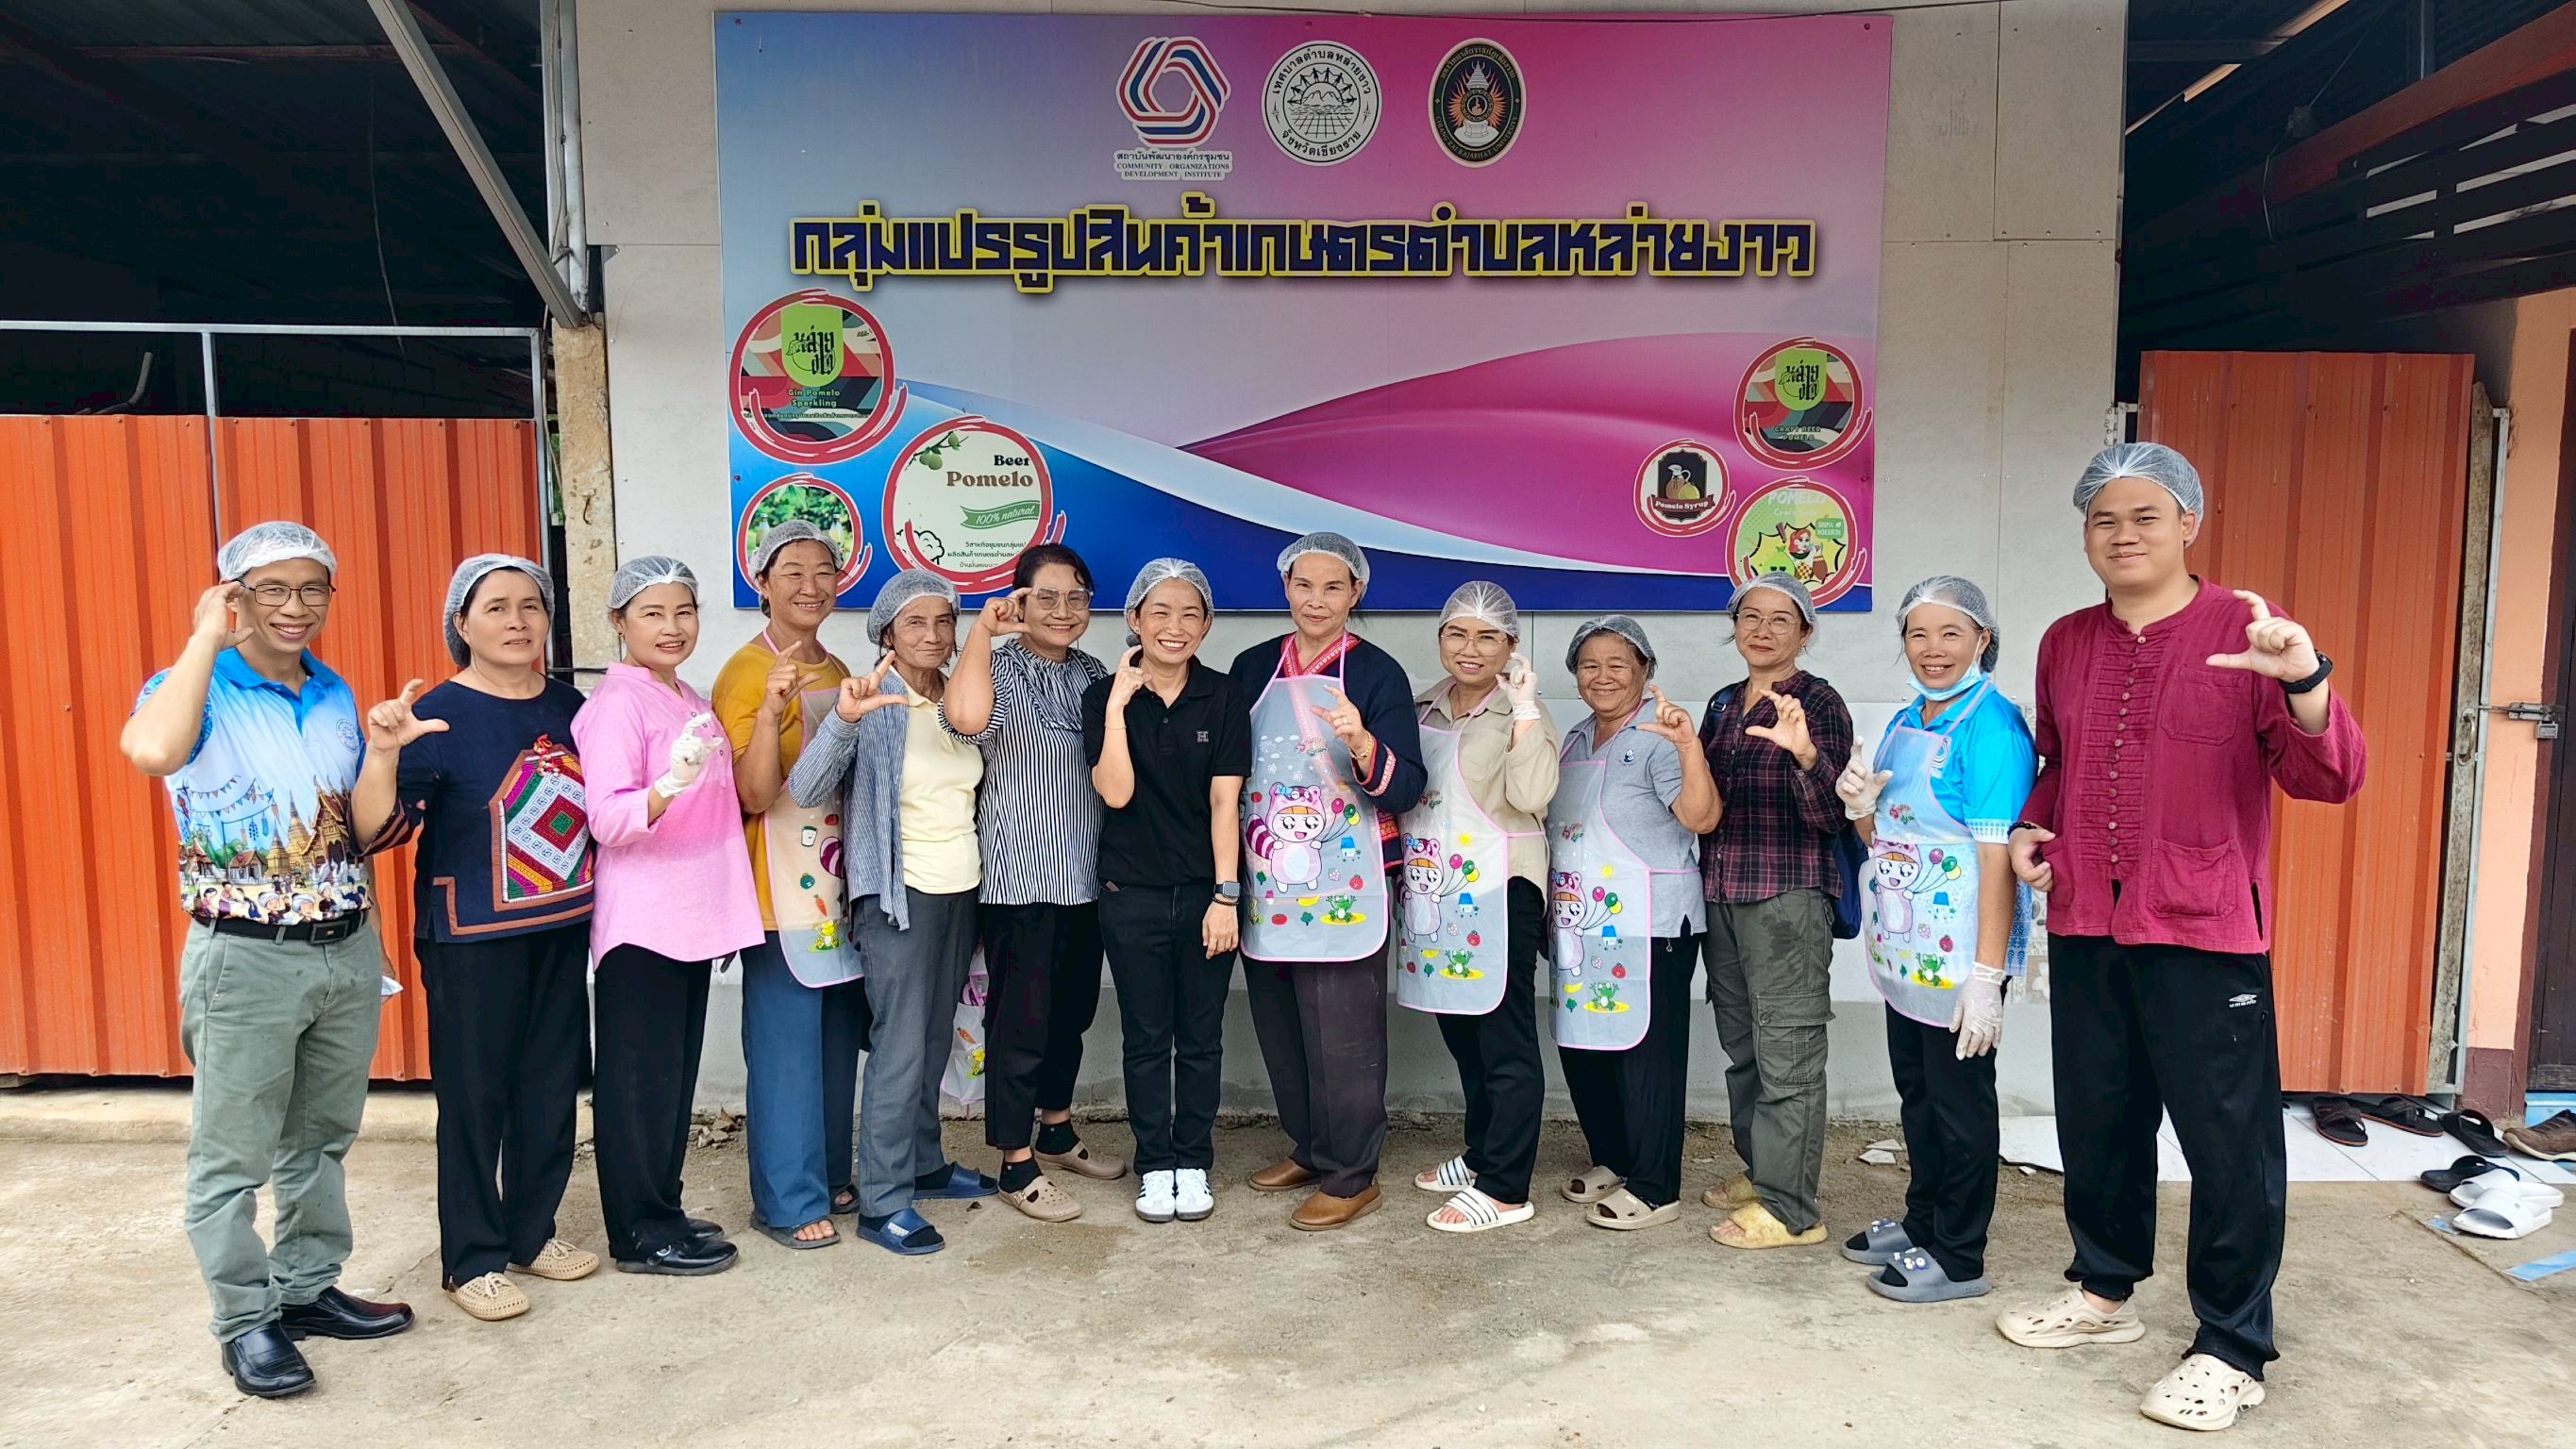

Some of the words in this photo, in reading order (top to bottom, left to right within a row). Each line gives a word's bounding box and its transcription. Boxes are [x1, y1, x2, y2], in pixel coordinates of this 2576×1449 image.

[1272, 48, 1371, 94] เทศบาลตำบลหล่ายงาว
[1282, 128, 1362, 157] จังหวัดเชียงราย
[1116, 150, 1229, 163] สถาบันพัฒนาองค์กรชุมชน
[791, 192, 1816, 292] กลุ่มแปรรูปสินค้าเกษตรตำบลหล่ายงาว
[806, 388, 841, 396] Pomelo
[792, 398, 837, 408] Sparkling
[994, 455, 1030, 466] Beer
[946, 471, 1033, 487] Pomelo
[1655, 500, 1683, 509] Pomelo
[1683, 500, 1709, 510] Syrup
[976, 510, 1000, 525] 100%
[1001, 505, 1036, 521] natural
